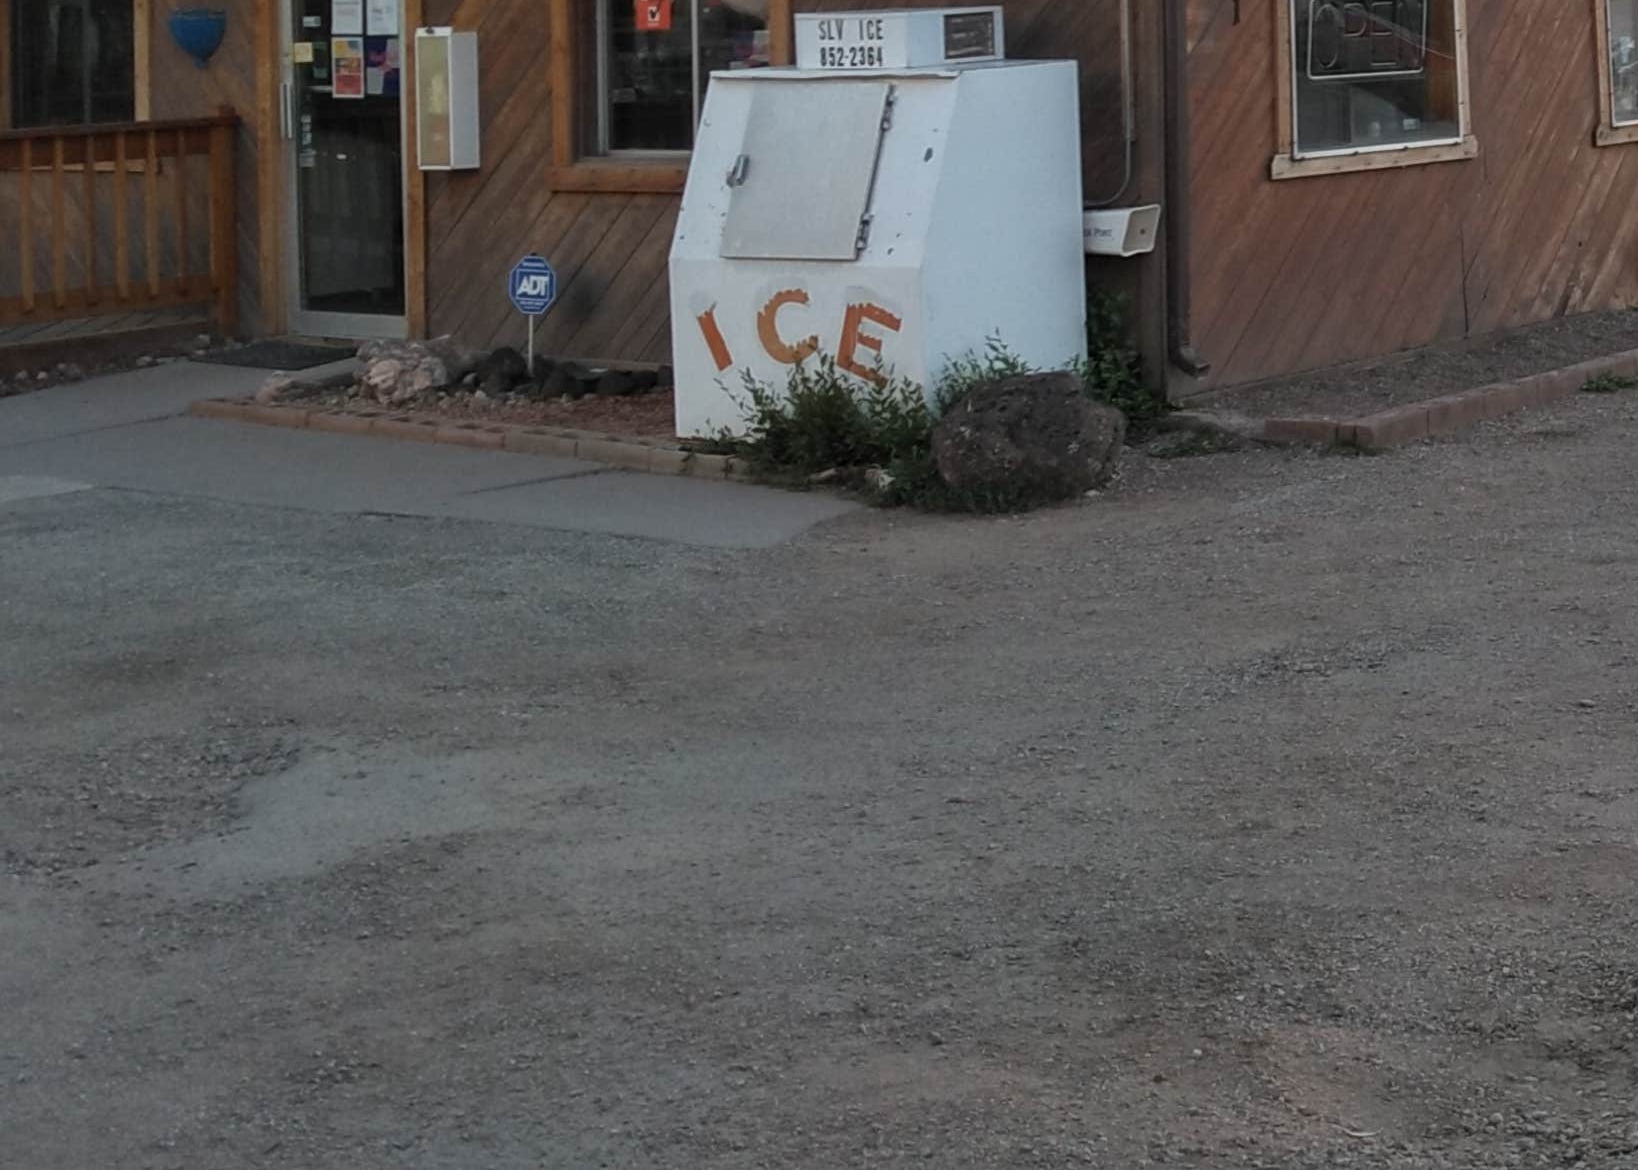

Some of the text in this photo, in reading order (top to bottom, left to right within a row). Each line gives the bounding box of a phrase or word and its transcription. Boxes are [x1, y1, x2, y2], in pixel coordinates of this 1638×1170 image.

[818, 18, 884, 41] SLV ICE
[1314, 1, 1422, 70] OPE
[516, 275, 549, 296] ADT
[697, 287, 902, 388] ICE
